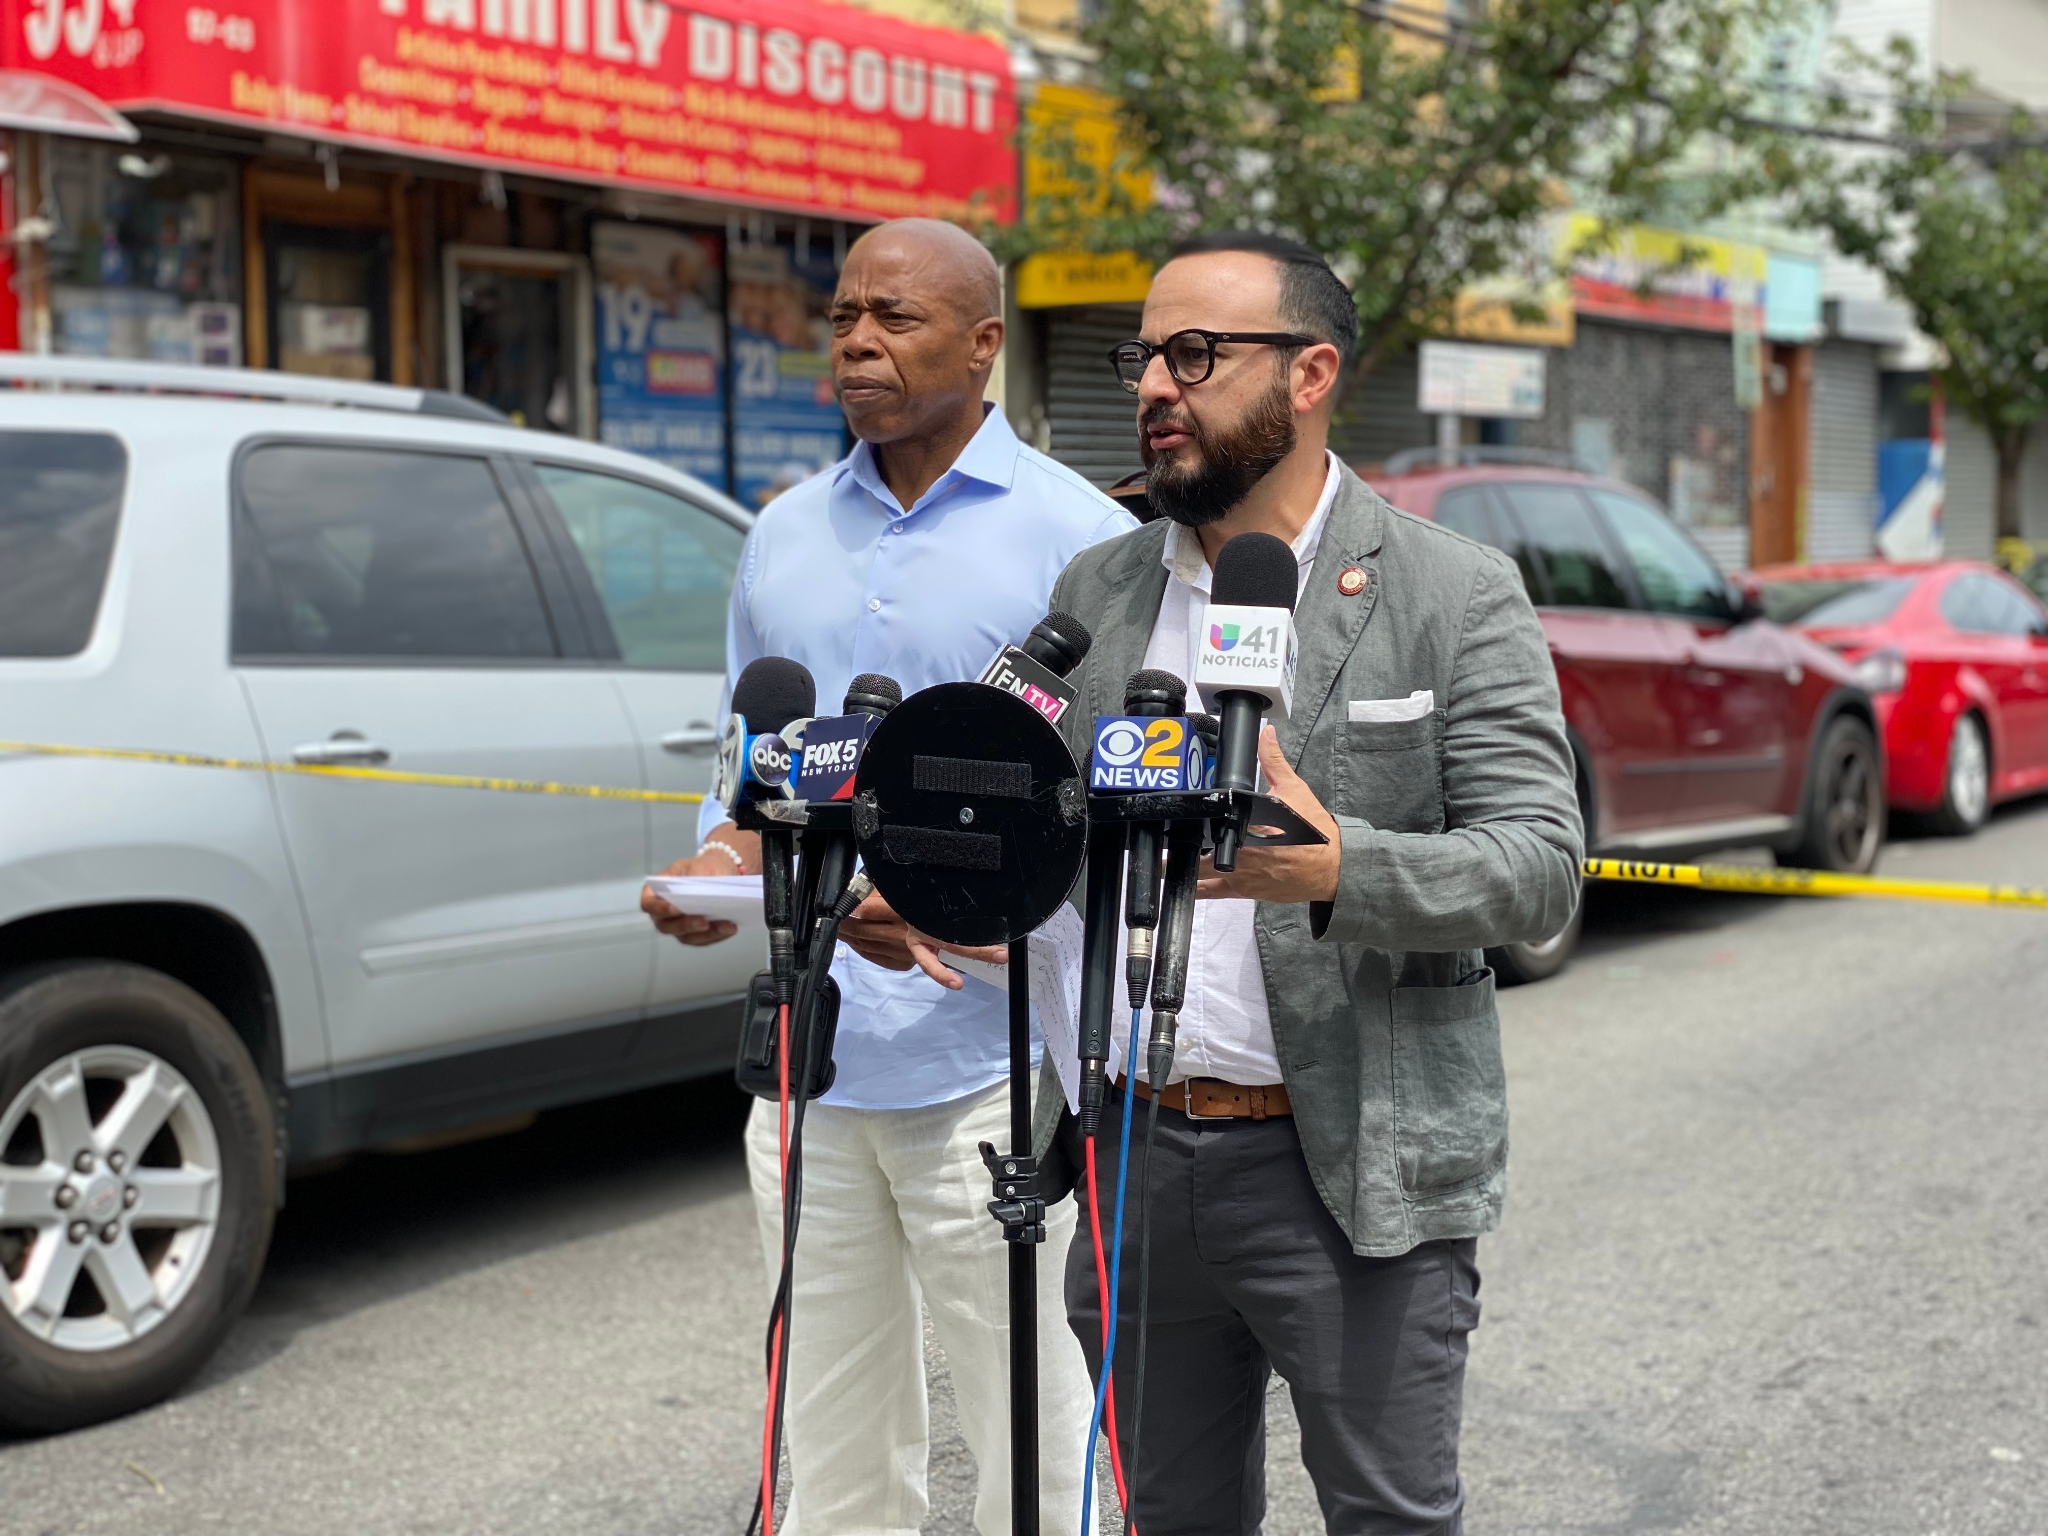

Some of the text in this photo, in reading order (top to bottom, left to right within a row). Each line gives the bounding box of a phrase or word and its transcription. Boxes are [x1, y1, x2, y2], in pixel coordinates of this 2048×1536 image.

[687, 12, 998, 133] DISCOUNT
[1241, 625, 1279, 654] 41
[1202, 653, 1279, 669] NOTICIAS
[1141, 718, 1184, 767] 2
[753, 743, 793, 772] abc
[801, 762, 856, 777] NEW YORK
[1094, 767, 1179, 788] NEWS
